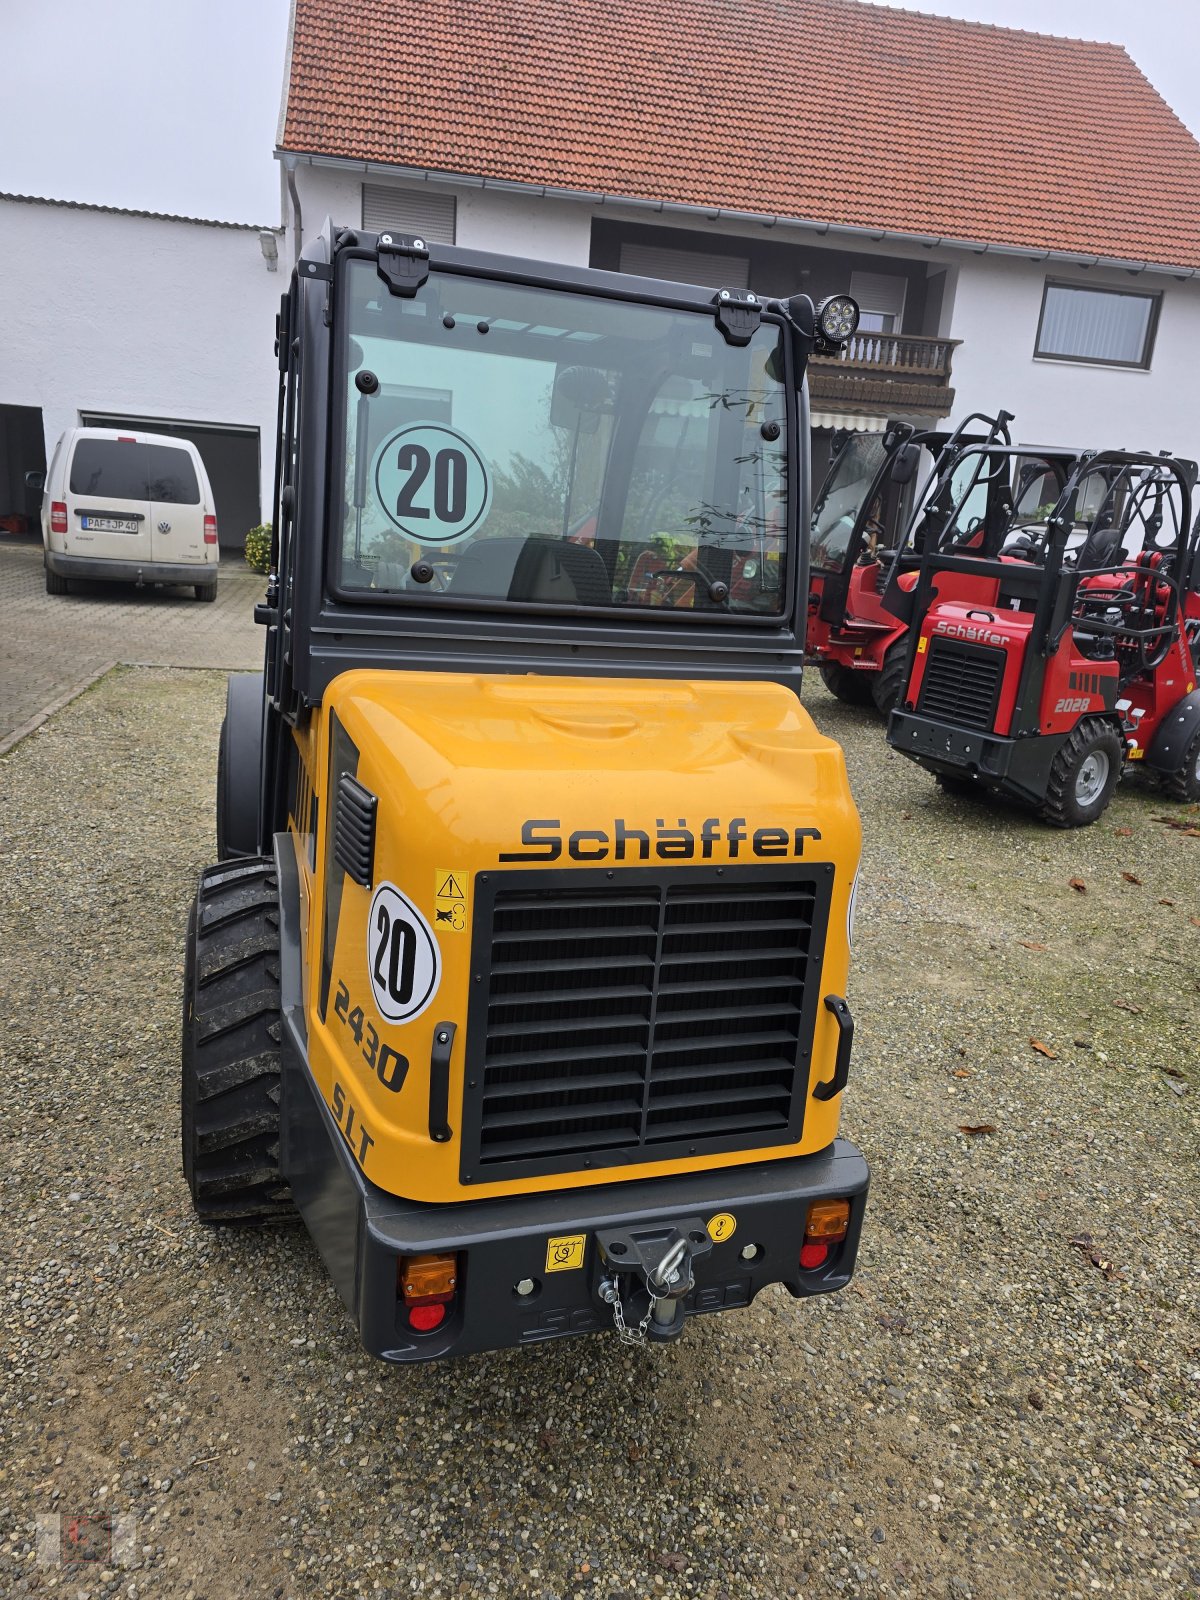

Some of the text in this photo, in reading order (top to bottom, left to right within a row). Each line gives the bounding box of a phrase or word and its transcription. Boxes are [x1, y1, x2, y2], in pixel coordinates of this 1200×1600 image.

[396, 443, 468, 523] 20
[88, 518, 137, 531] PAF JP 40
[932, 621, 1010, 646] Schäffer
[1054, 698, 1090, 713] 2028
[498, 818, 822, 863] Schäffer
[373, 904, 417, 1005] 20
[334, 979, 410, 1093] 2430
[330, 1082, 375, 1167] SLT
